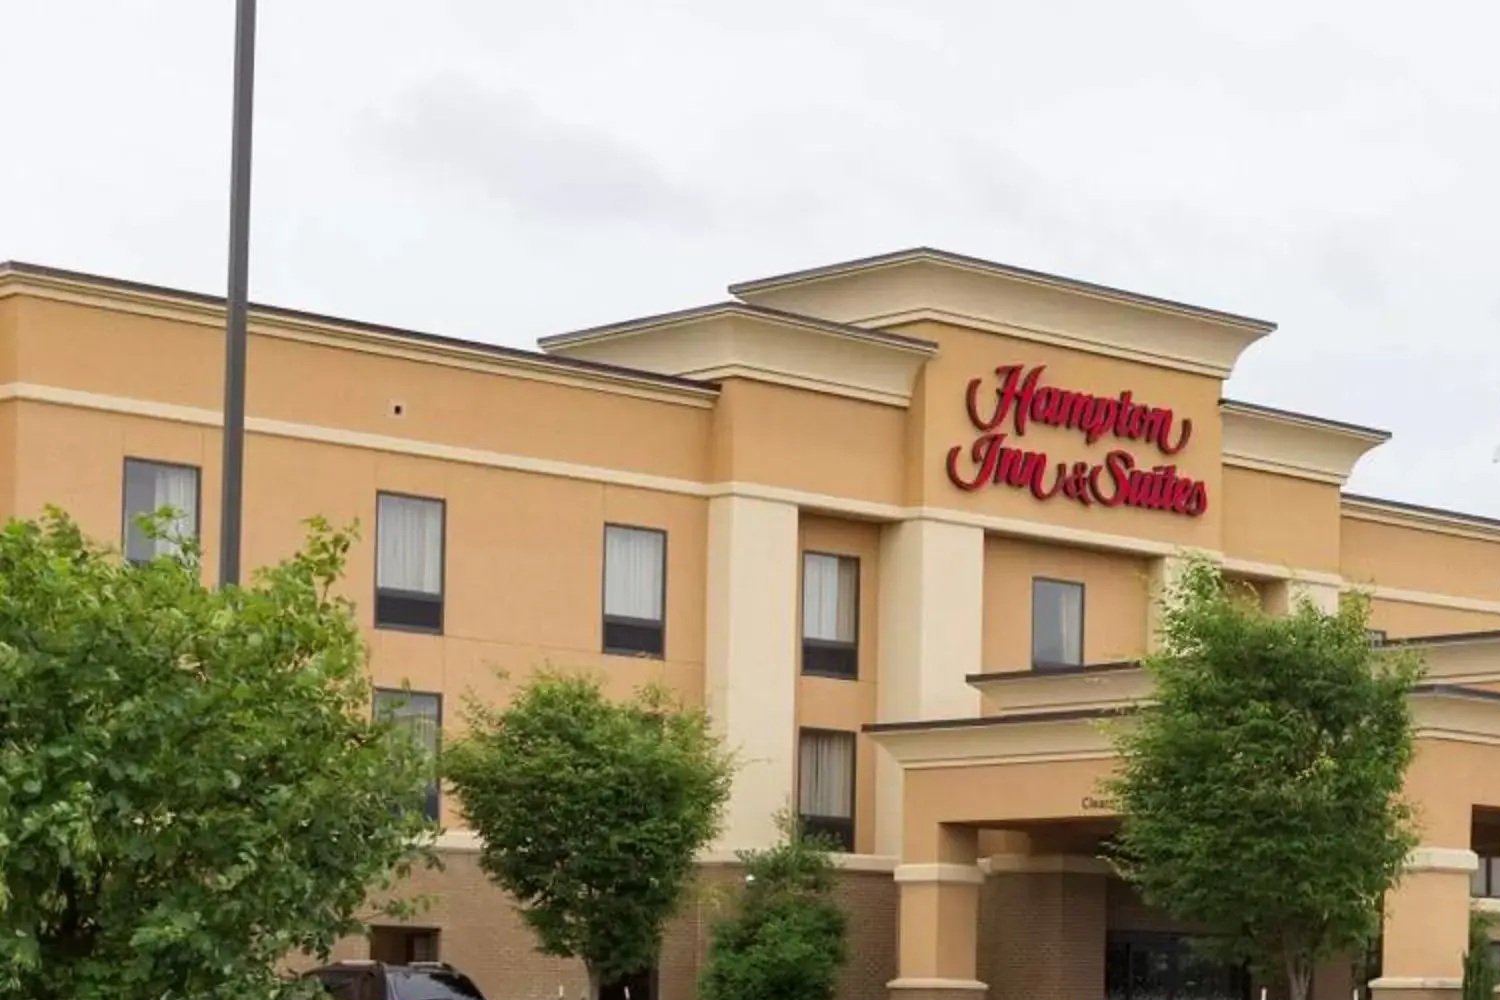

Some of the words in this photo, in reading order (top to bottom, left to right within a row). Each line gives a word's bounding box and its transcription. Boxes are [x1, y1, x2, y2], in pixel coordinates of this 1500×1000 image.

[965, 363, 1192, 455] Hampton
[946, 433, 1067, 501] Inn
[1063, 461, 1093, 508] &
[1089, 449, 1208, 517] Suites
